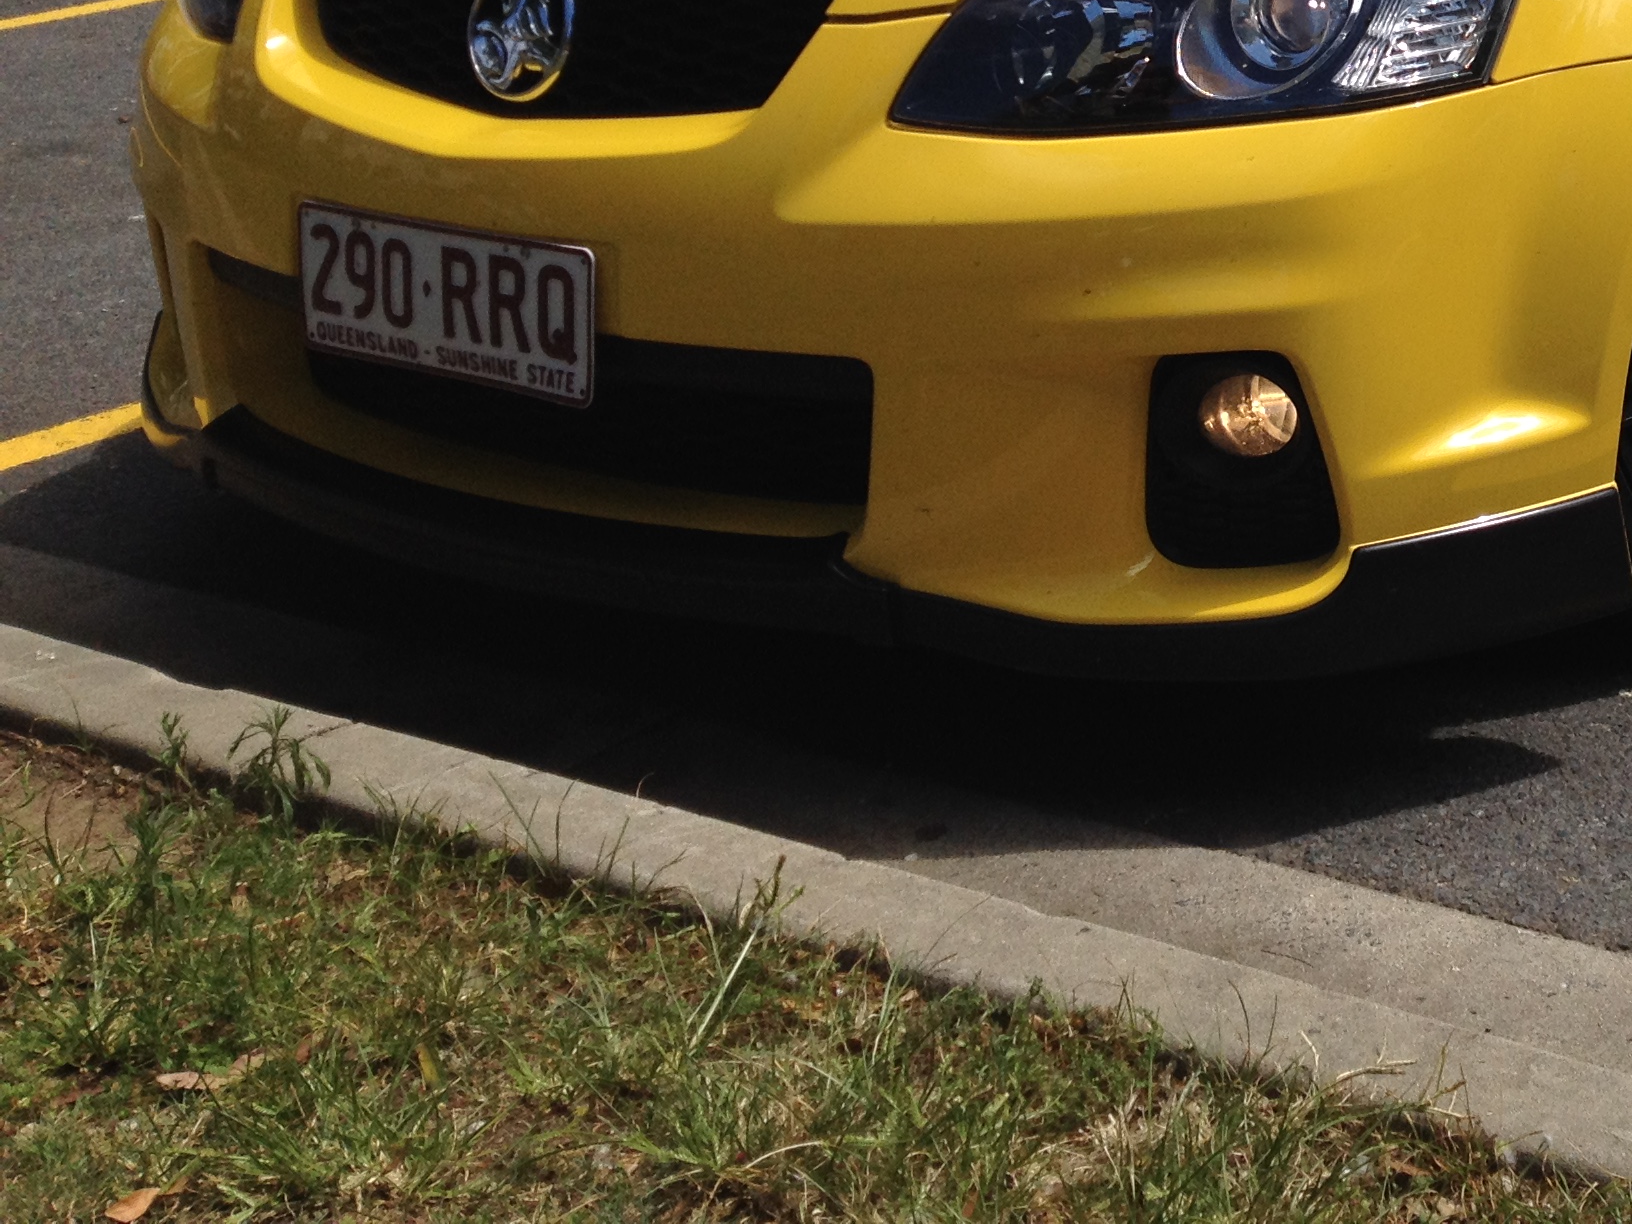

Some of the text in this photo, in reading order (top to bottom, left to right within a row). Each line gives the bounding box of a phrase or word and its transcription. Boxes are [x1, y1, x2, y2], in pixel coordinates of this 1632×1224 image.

[316, 321, 576, 394] QUEENSLAND SUNSHINE STATE
